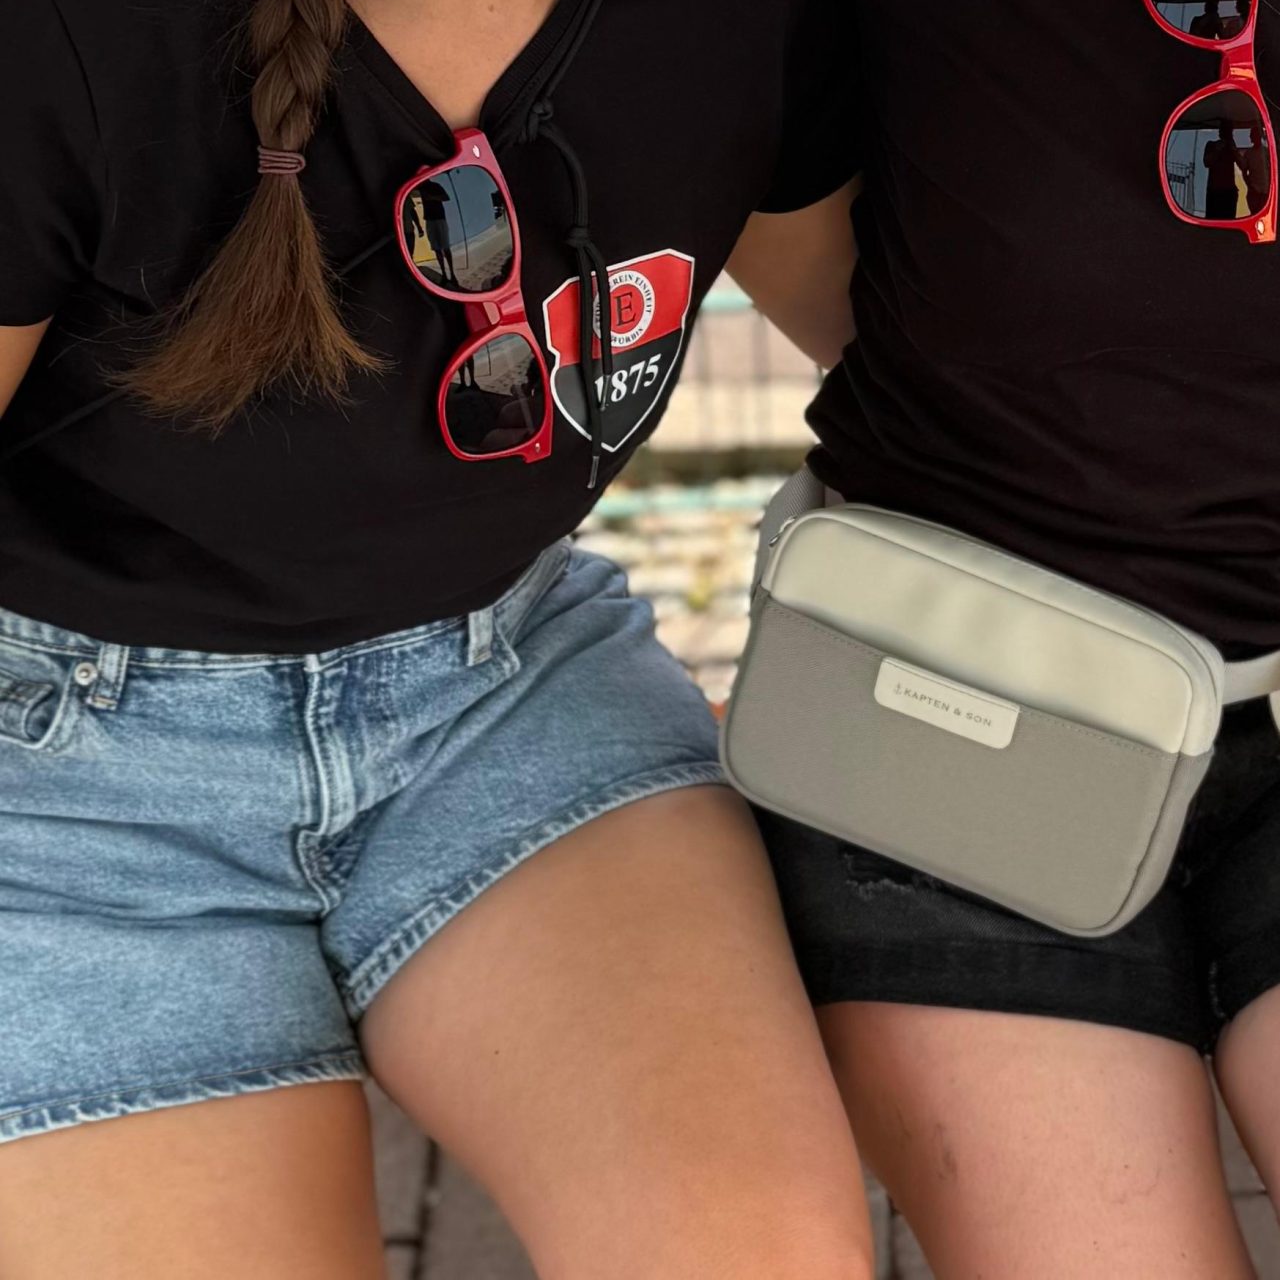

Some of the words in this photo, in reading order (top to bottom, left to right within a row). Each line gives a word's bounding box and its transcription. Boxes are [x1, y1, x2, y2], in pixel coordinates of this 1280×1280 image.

[614, 291, 636, 326] E
[904, 689, 950, 712] KAPTEN
[953, 707, 962, 716] &
[966, 712, 992, 727] SON
